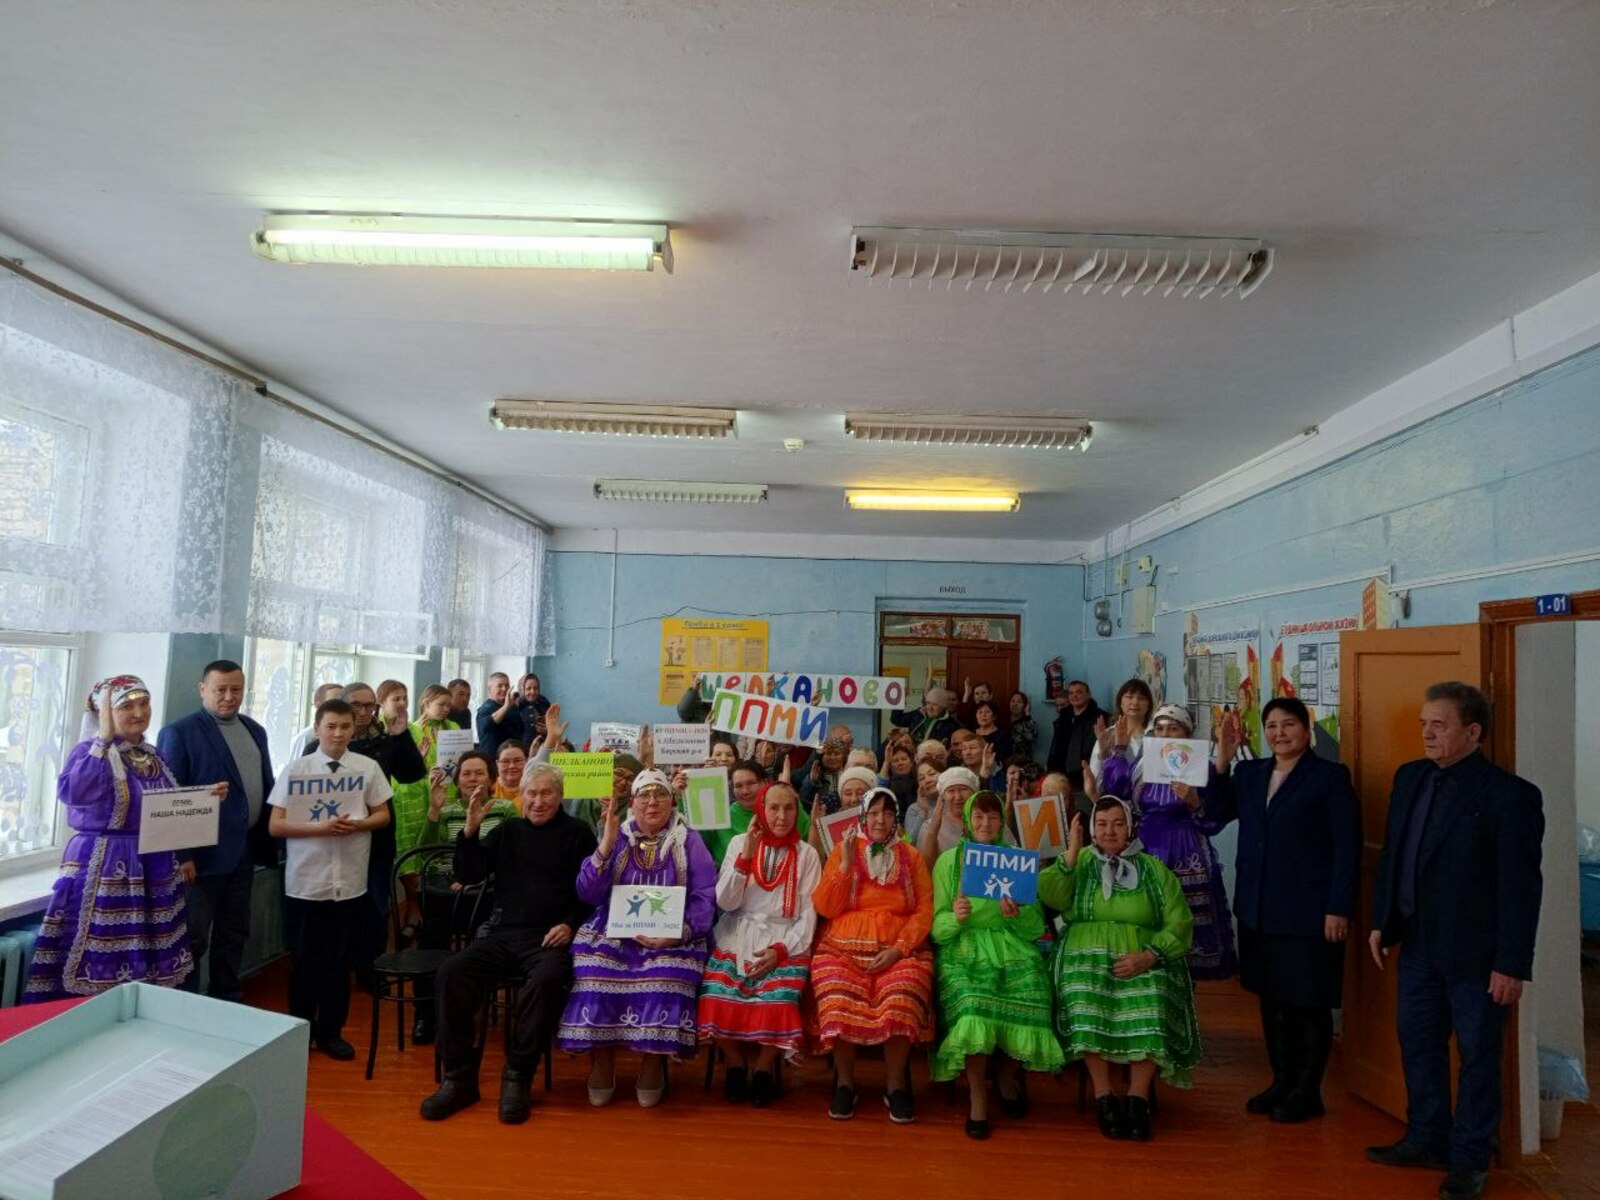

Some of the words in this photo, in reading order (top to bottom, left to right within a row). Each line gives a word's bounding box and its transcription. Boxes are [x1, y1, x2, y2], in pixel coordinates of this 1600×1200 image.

[939, 586, 967, 594] ВЫХОД
[714, 690, 827, 741] ППМИ
[288, 775, 364, 795] ППМИ
[150, 809, 175, 819] НАША
[176, 807, 213, 818] НАДЕЖДА
[965, 849, 1036, 873] ППМИ
